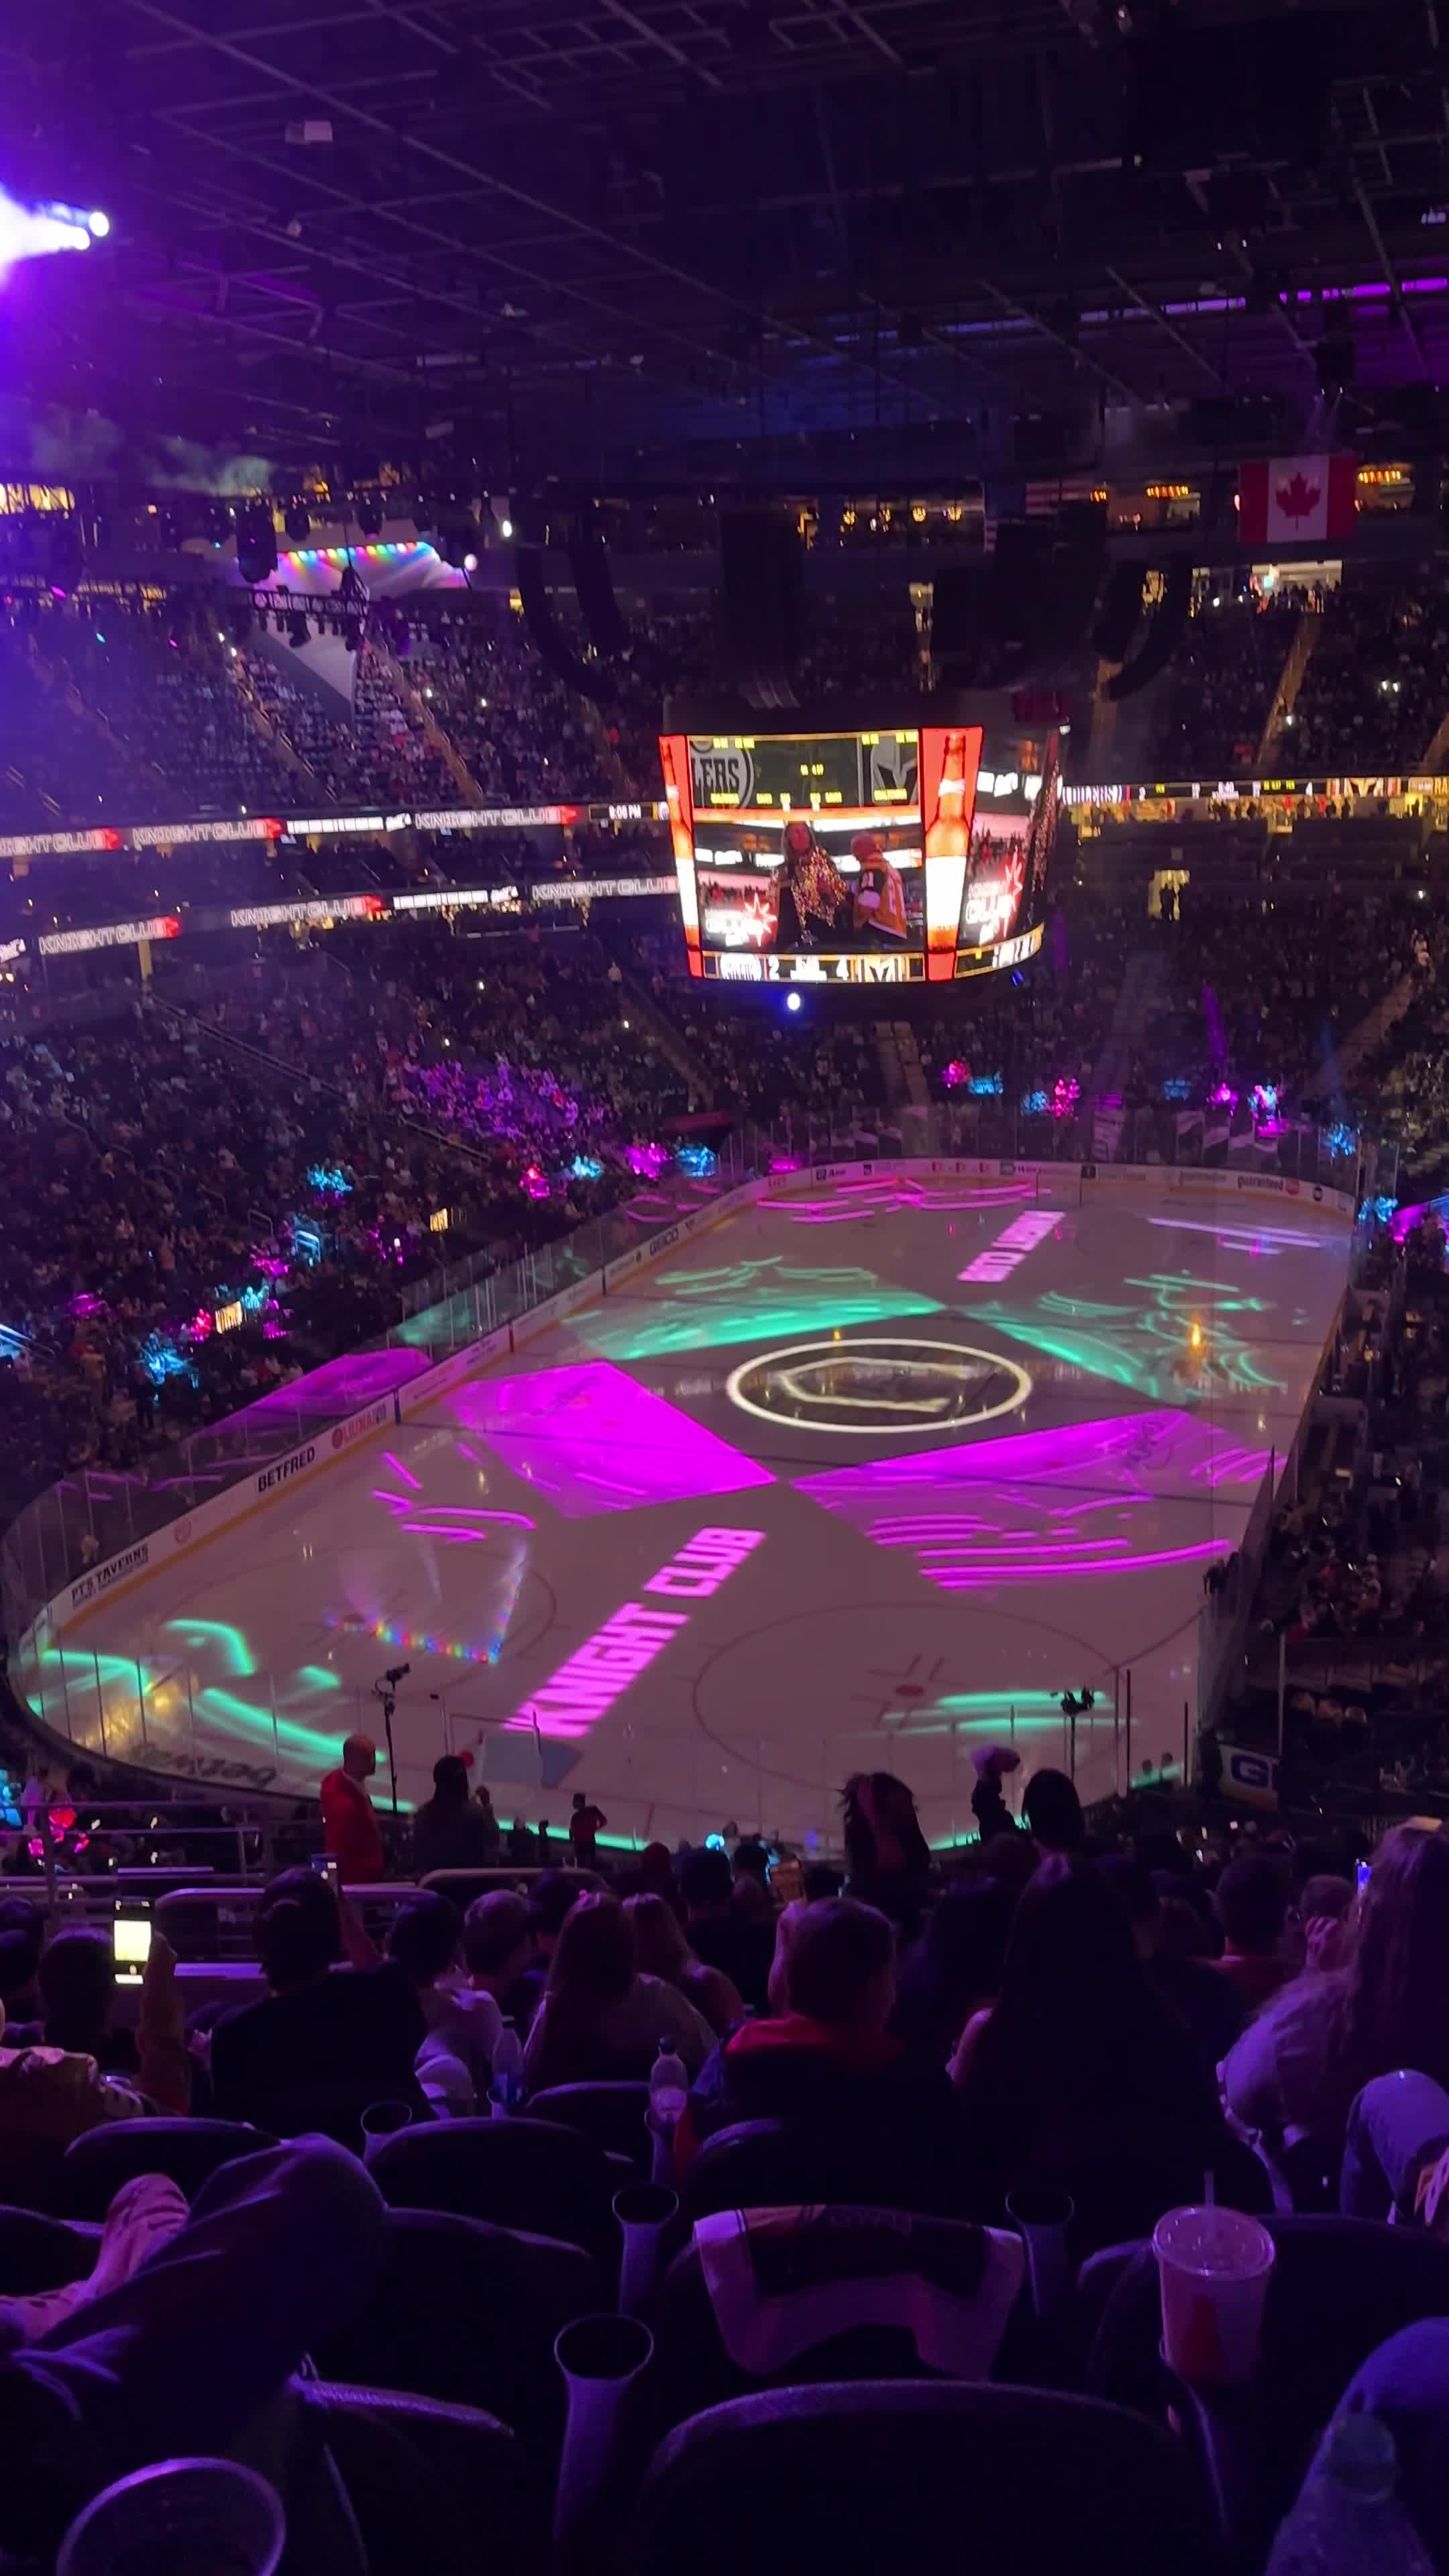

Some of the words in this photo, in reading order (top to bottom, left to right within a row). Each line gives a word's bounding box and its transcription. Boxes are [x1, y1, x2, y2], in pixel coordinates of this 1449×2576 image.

[628, 804, 641, 819] PM
[531, 879, 616, 900] KNIGHT
[768, 955, 780, 980] 2
[836, 955, 849, 981] 4
[258, 1446, 315, 1493] BETFRED
[500, 1602, 690, 1737] KNIGHT
[642, 1526, 766, 1597] CLUB
